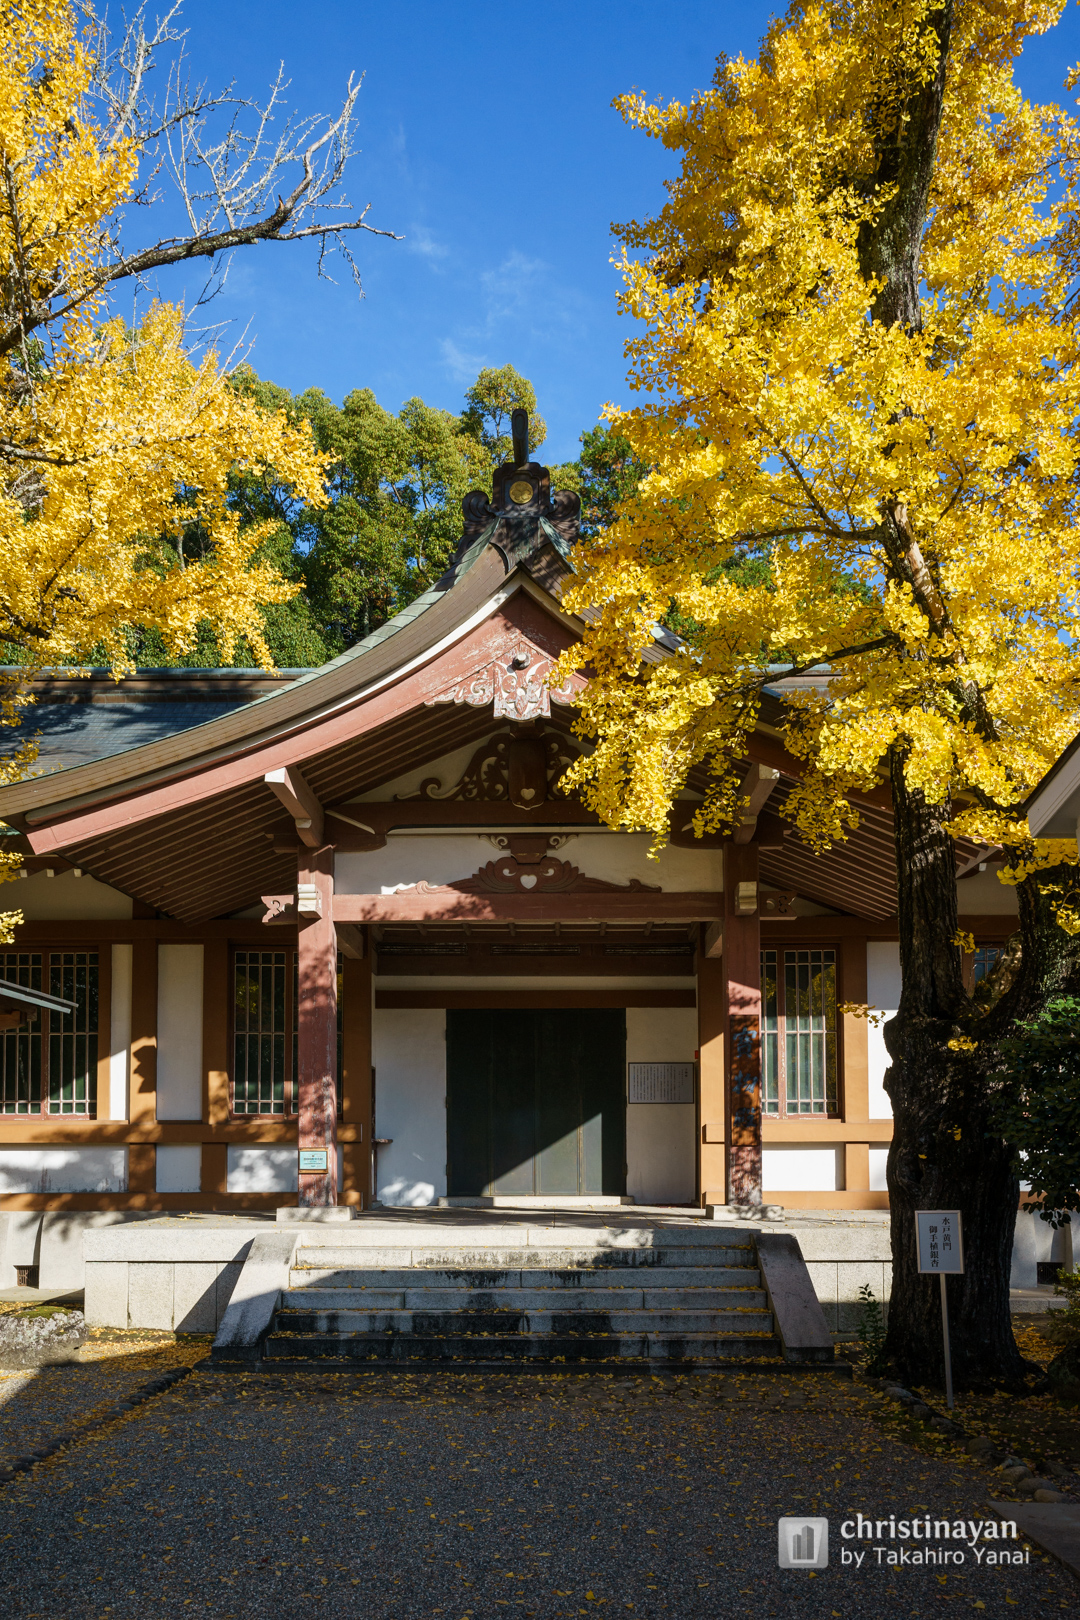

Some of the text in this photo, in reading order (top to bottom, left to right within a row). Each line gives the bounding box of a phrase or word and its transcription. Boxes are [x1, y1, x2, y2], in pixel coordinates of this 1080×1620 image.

[929, 1225, 939, 1268] 御手植銀杏
[942, 1217, 952, 1251] 水戸黄門
